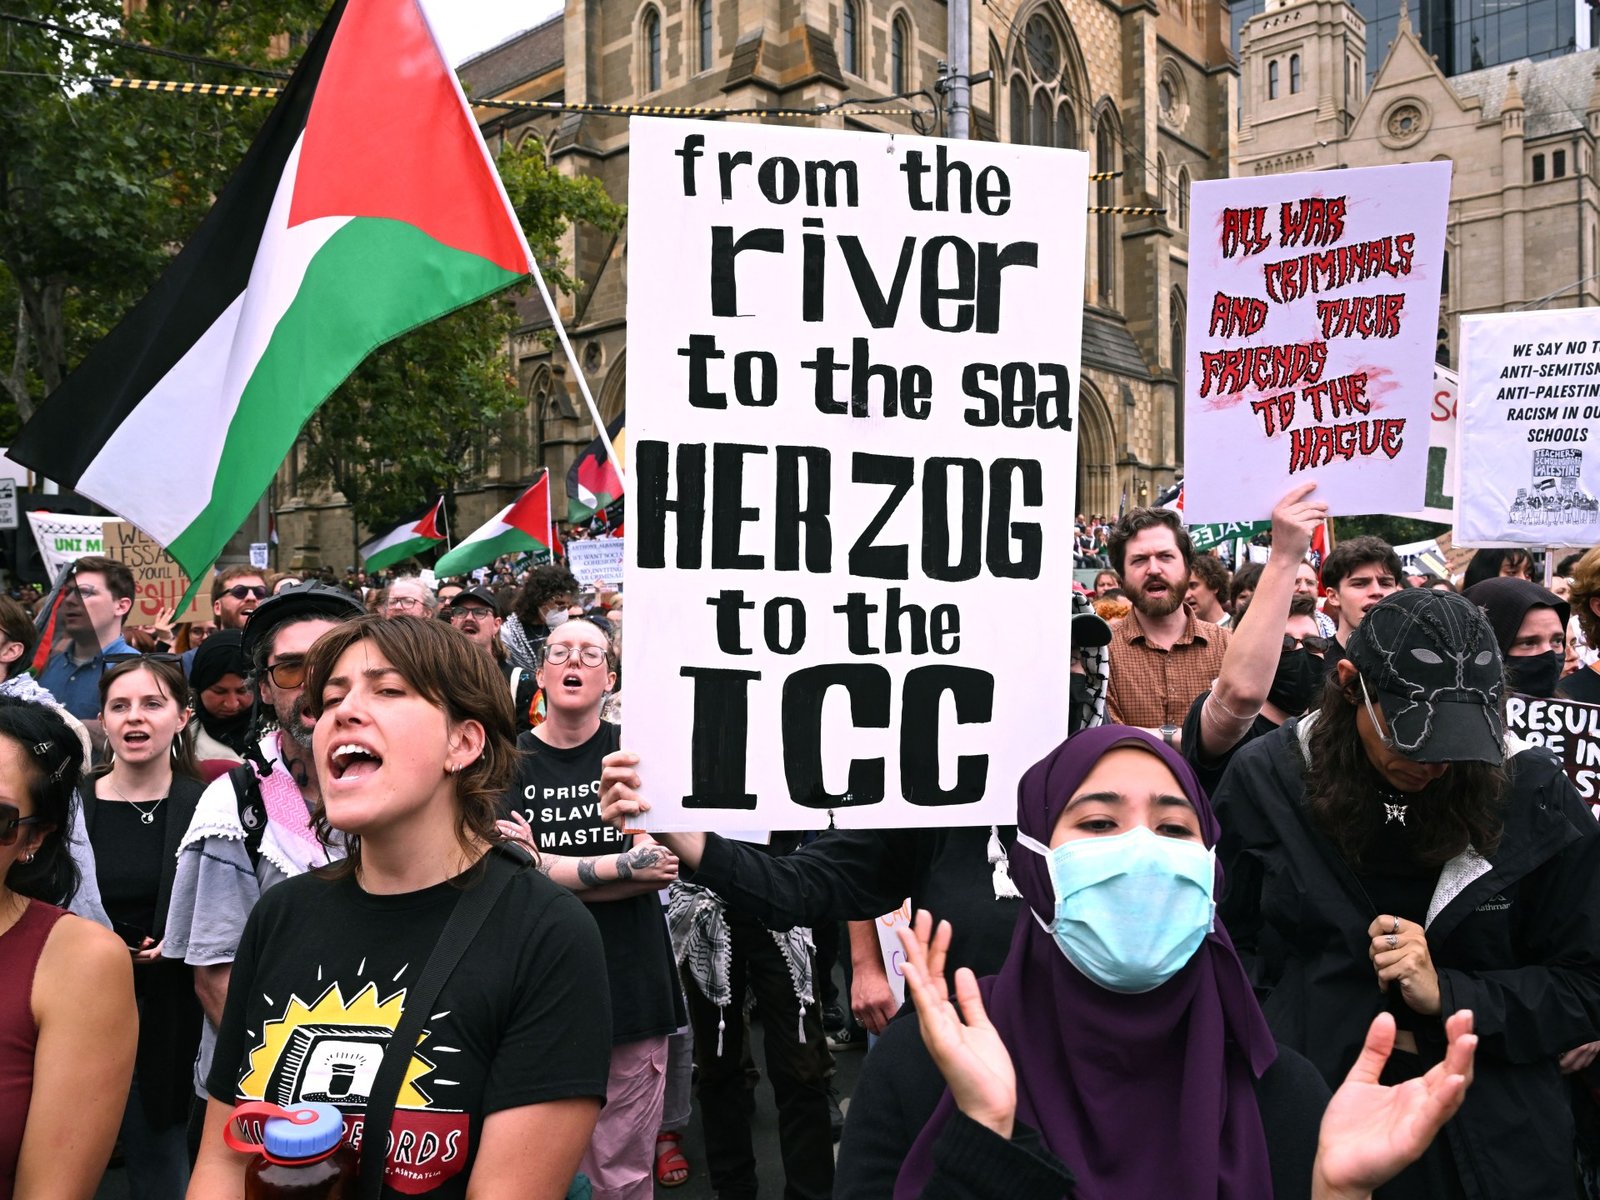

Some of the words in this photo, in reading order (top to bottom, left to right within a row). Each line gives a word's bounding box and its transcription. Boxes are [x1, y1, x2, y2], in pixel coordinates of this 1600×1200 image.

[675, 134, 859, 206] from
[900, 145, 1011, 216] the
[1222, 206, 1271, 259] ALL
[1279, 195, 1346, 248] WAR
[711, 218, 1038, 334] river
[1264, 233, 1415, 304] CRIMINALS
[1209, 291, 1268, 339] AND
[1317, 293, 1405, 340] THEIR
[1200, 341, 1328, 398] FRIENDS
[1513, 343, 1533, 357] WE
[1536, 342, 1563, 356] SAY
[1566, 341, 1587, 355] NO
[677, 334, 778, 409] to
[801, 337, 932, 420] the
[962, 362, 1072, 431] sea
[1251, 391, 1295, 437] TO
[1302, 372, 1371, 422] THE
[1496, 383, 1600, 401] ANTI-PALESTIN
[1507, 406, 1559, 421] RACISM
[1562, 406, 1579, 420] IN
[1583, 405, 1600, 420] OU
[1527, 427, 1589, 443] SCHOOLS
[1289, 419, 1406, 475] HAGUE
[636, 440, 1043, 582] HERZOG
[54, 538, 82, 552] UNI
[706, 590, 806, 655] to
[833, 587, 960, 655] the
[680, 663, 994, 810] ICC
[1506, 697, 1600, 739] RESUL
[543, 780, 601, 800] PRISO
